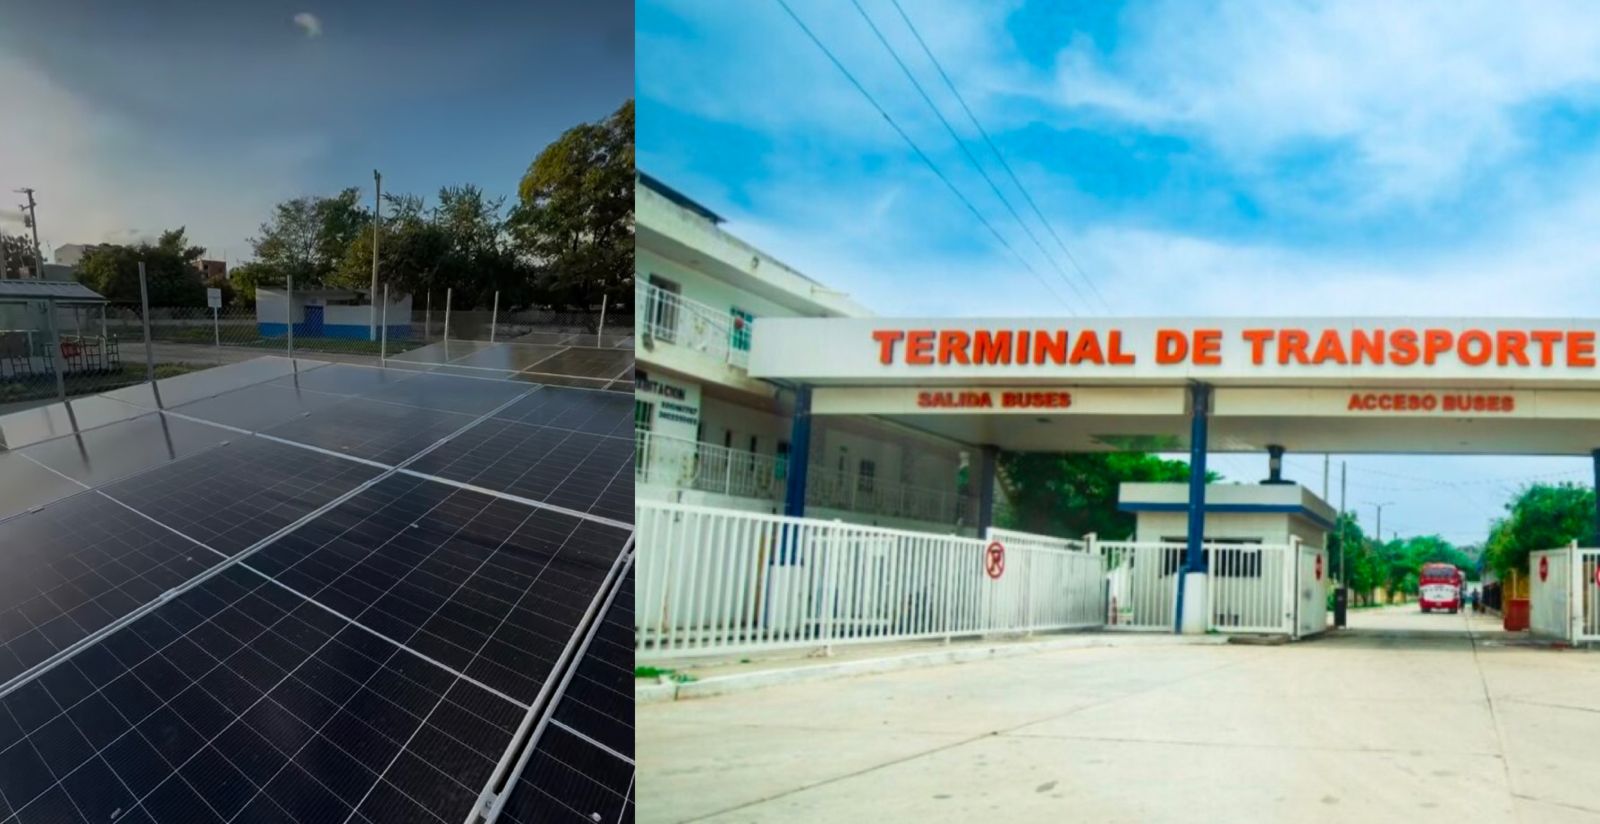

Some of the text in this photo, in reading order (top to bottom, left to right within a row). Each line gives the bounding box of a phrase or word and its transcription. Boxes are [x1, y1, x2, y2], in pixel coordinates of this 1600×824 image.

[872, 328, 1597, 368] TERMINAL DE TRANSPORTE
[917, 391, 1072, 409] SALIDA BUSES
[1347, 393, 1515, 412] ACCESO BUSES
